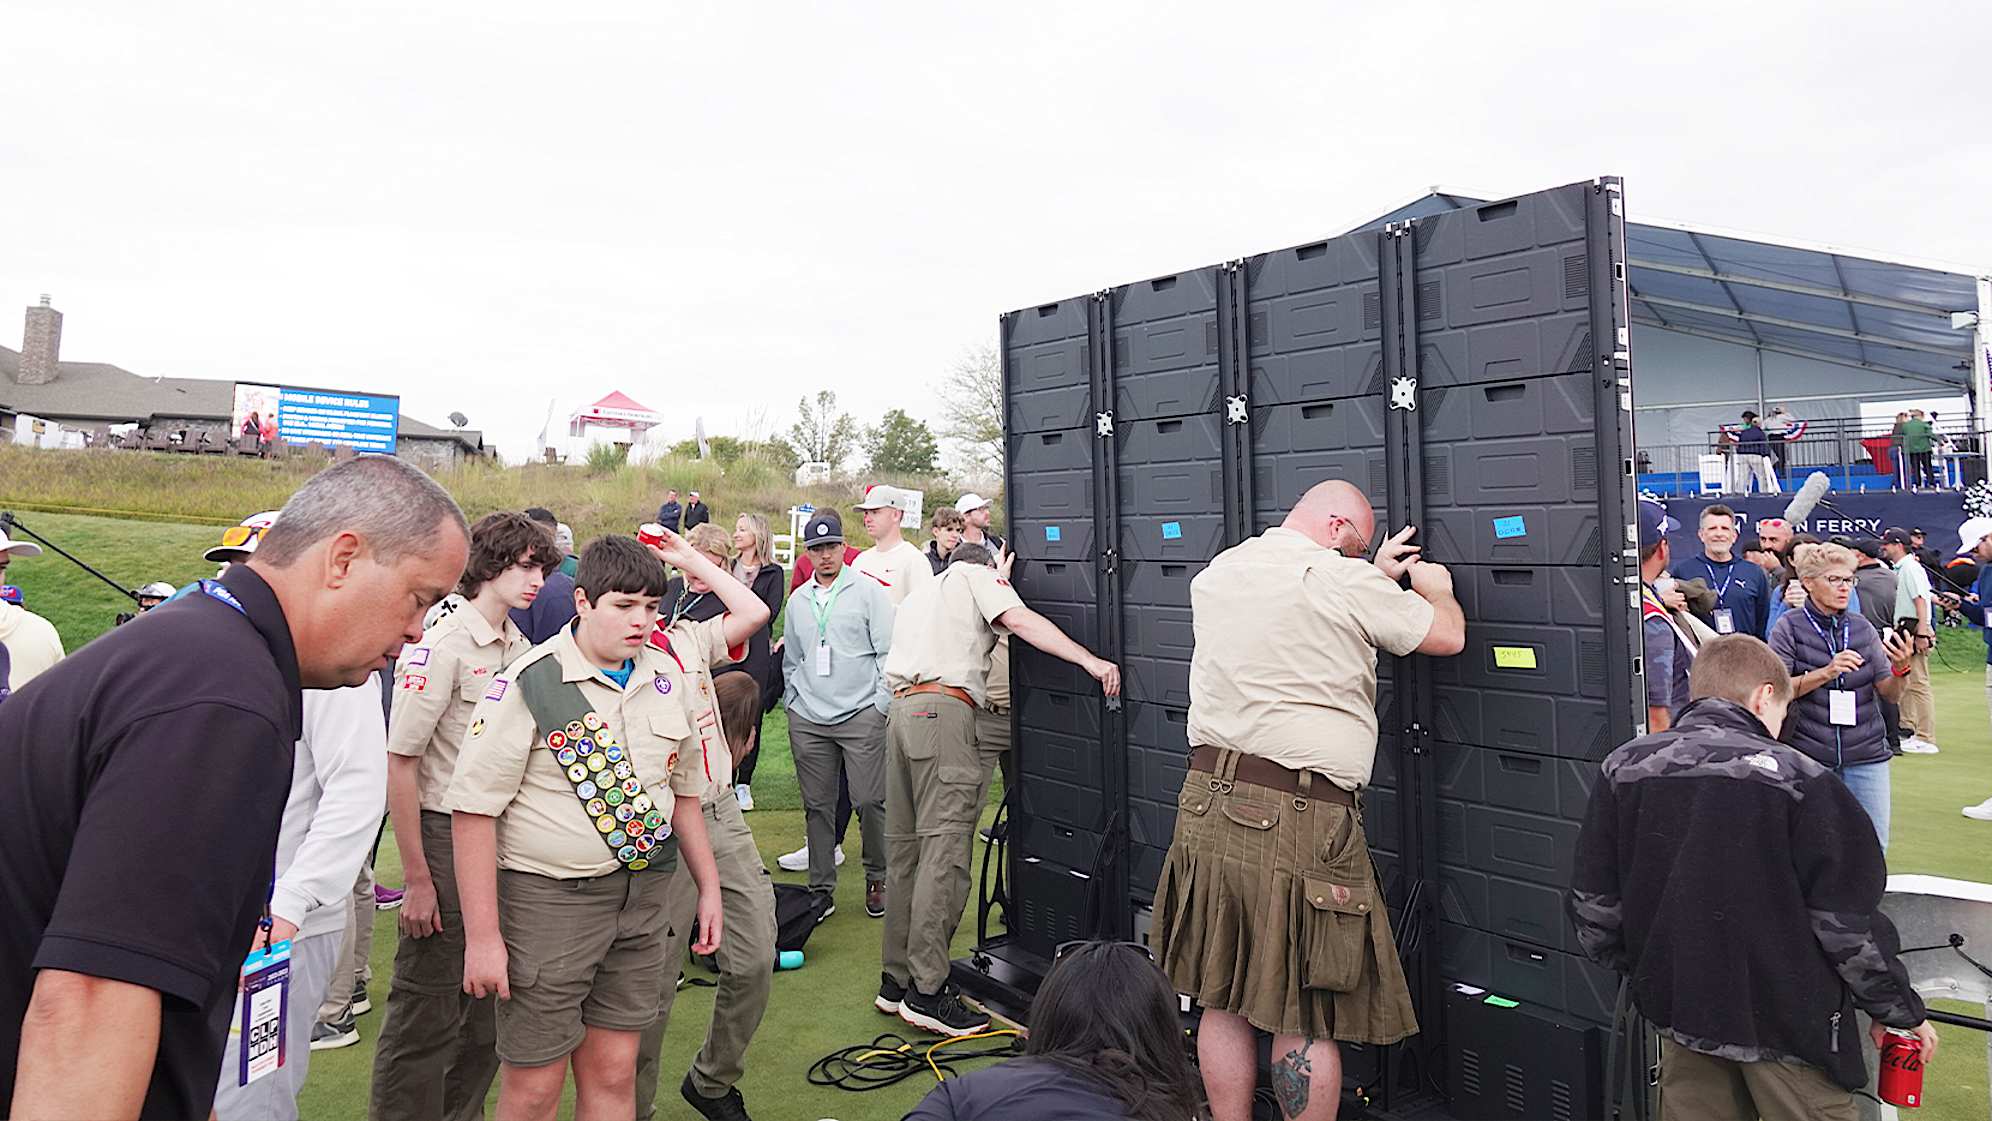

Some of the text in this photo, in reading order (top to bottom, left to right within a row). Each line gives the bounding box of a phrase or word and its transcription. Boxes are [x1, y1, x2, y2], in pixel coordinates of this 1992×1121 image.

[283, 393, 369, 409] MOBILE DEVICE RULES
[1816, 519, 1880, 532] FERRY
